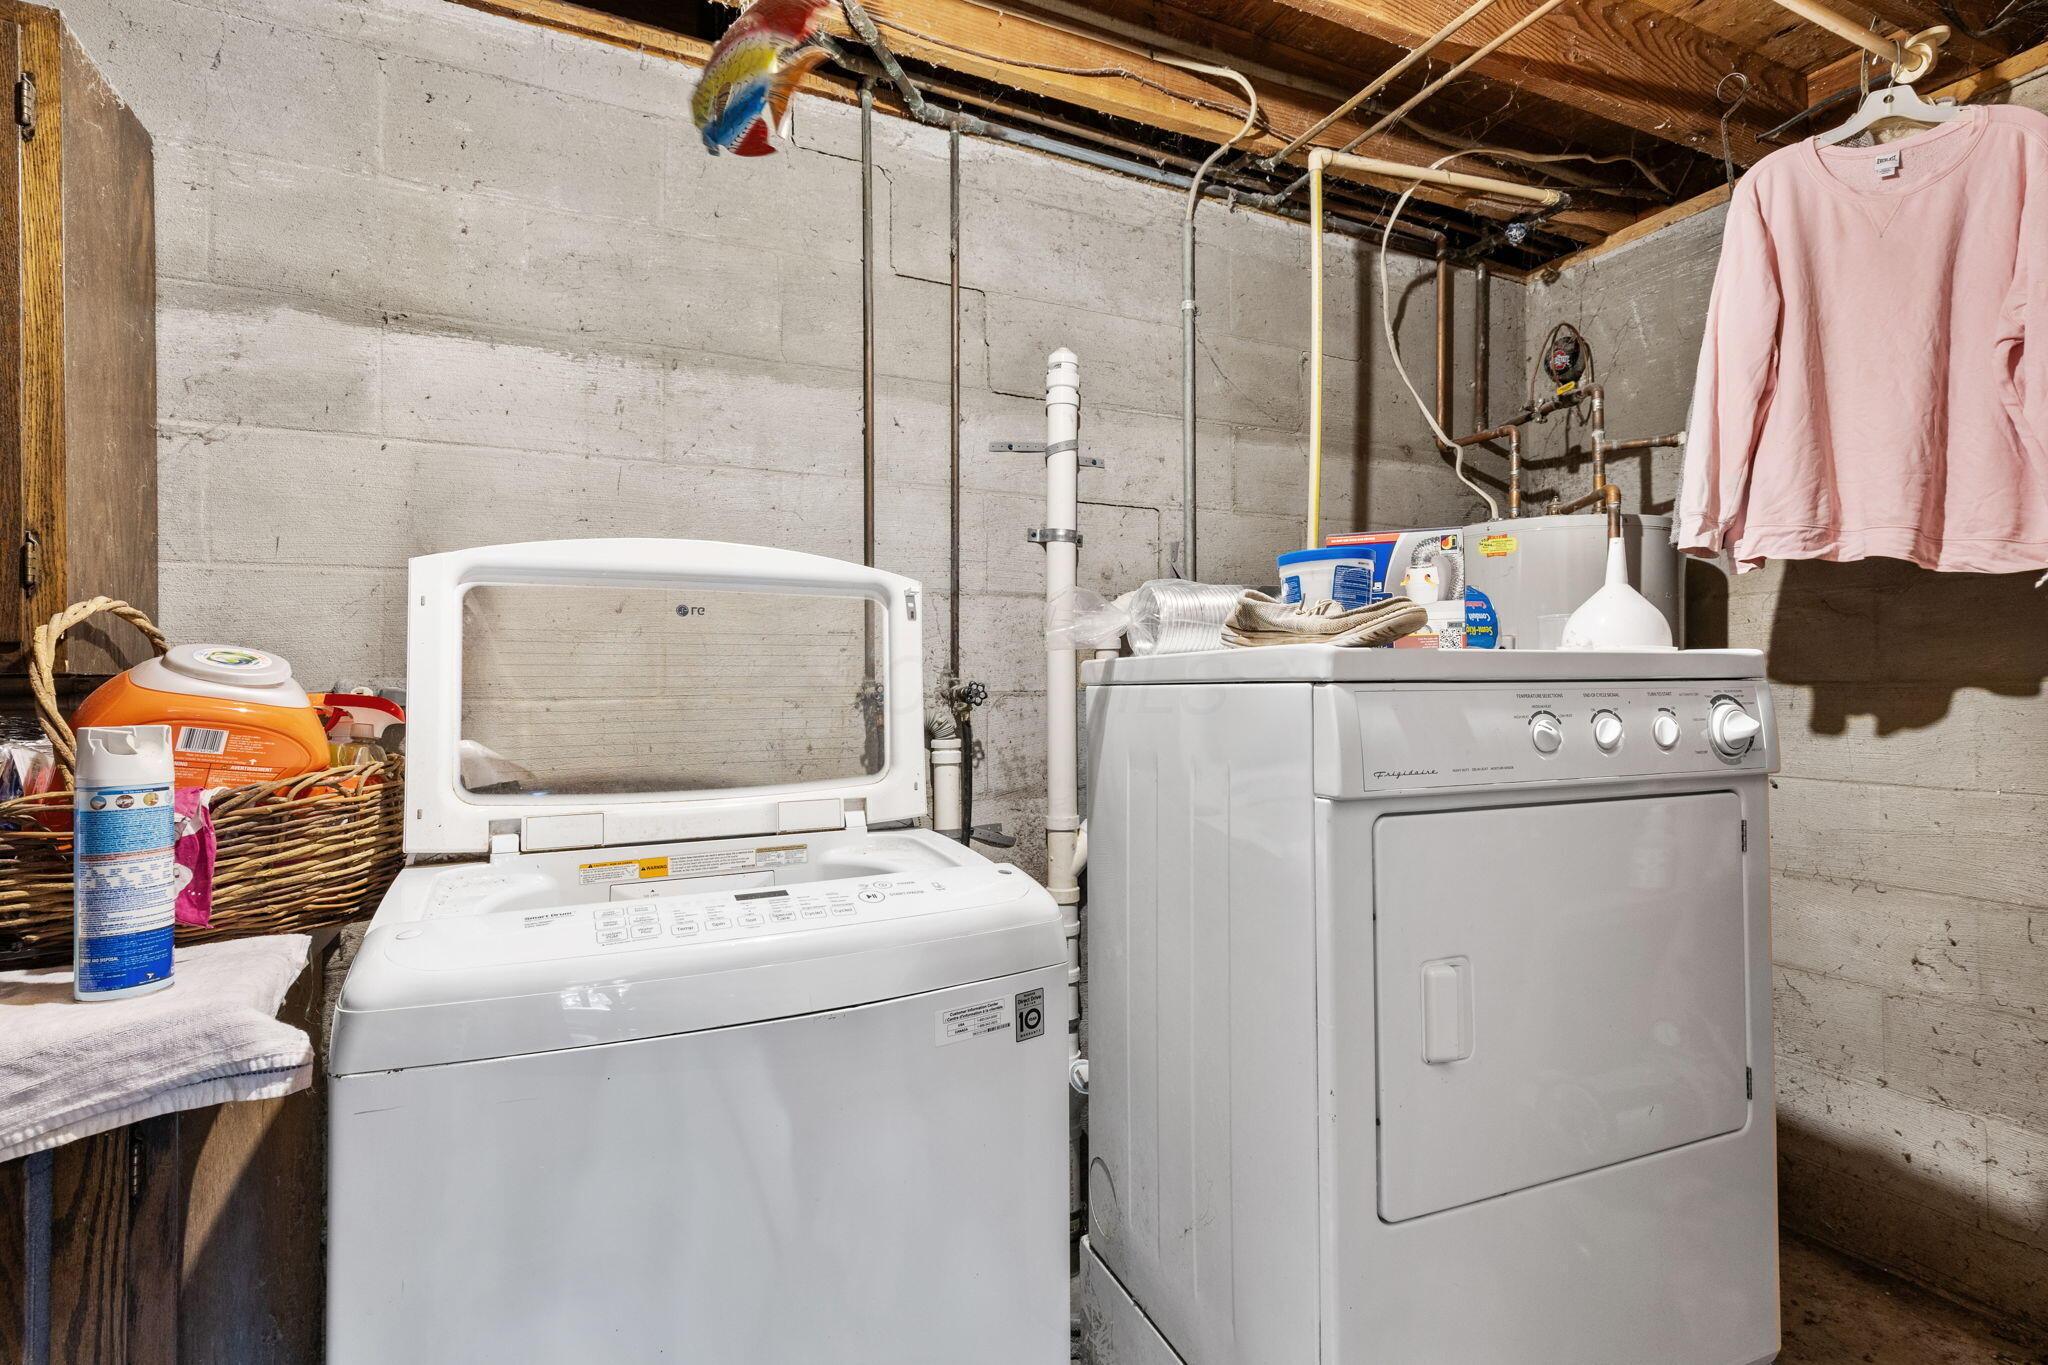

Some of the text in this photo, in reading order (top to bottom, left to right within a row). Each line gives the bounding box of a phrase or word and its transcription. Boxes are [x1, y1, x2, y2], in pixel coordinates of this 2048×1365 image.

[1468, 613, 1491, 622] Conduit
[1466, 625, 1493, 635] Semi-Rig
[1374, 769, 1438, 779] Frigidaire
[967, 1004, 986, 1012] Information
[1019, 1008, 1041, 1032] 10
